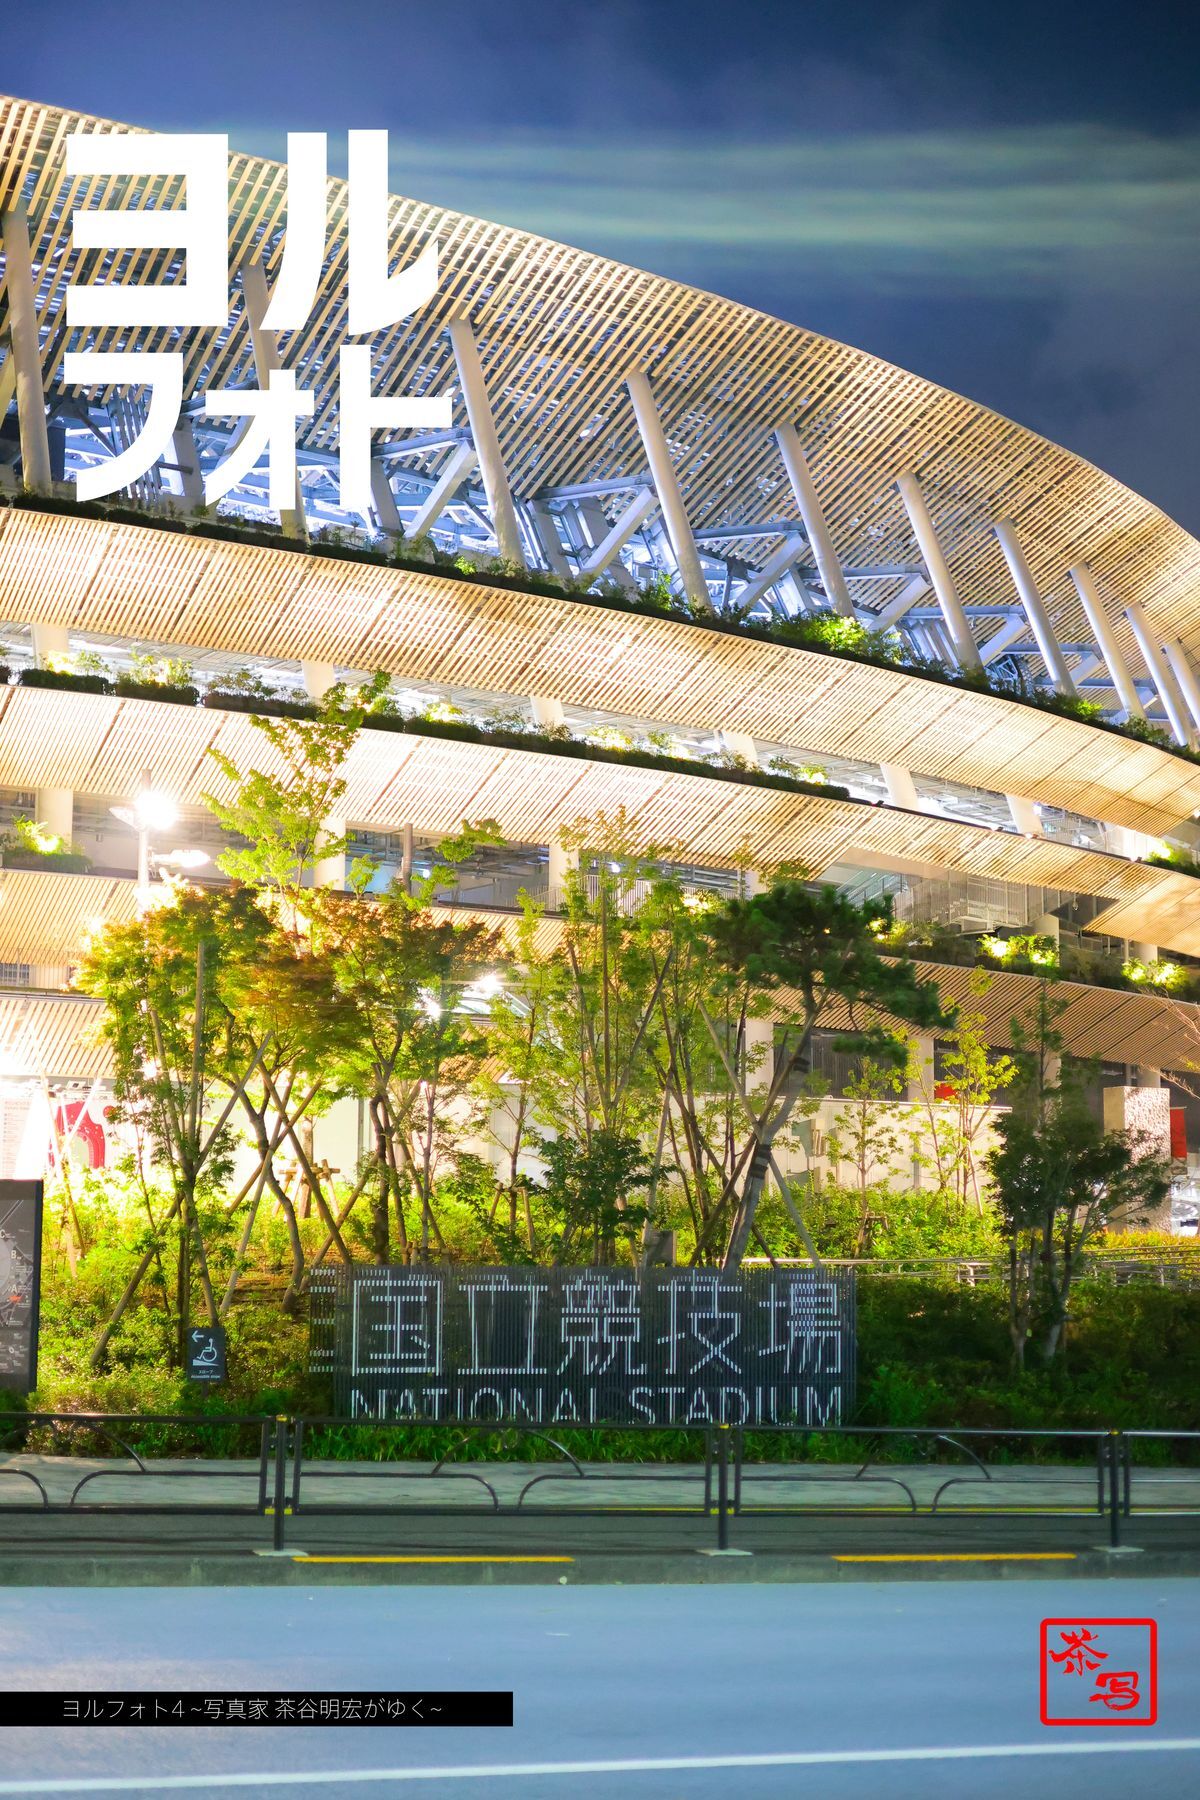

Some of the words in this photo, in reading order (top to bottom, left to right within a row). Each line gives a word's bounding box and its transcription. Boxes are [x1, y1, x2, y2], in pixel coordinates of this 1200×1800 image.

[352, 1272, 842, 1376] 国立競技場
[628, 1386, 842, 1426] STADIUM
